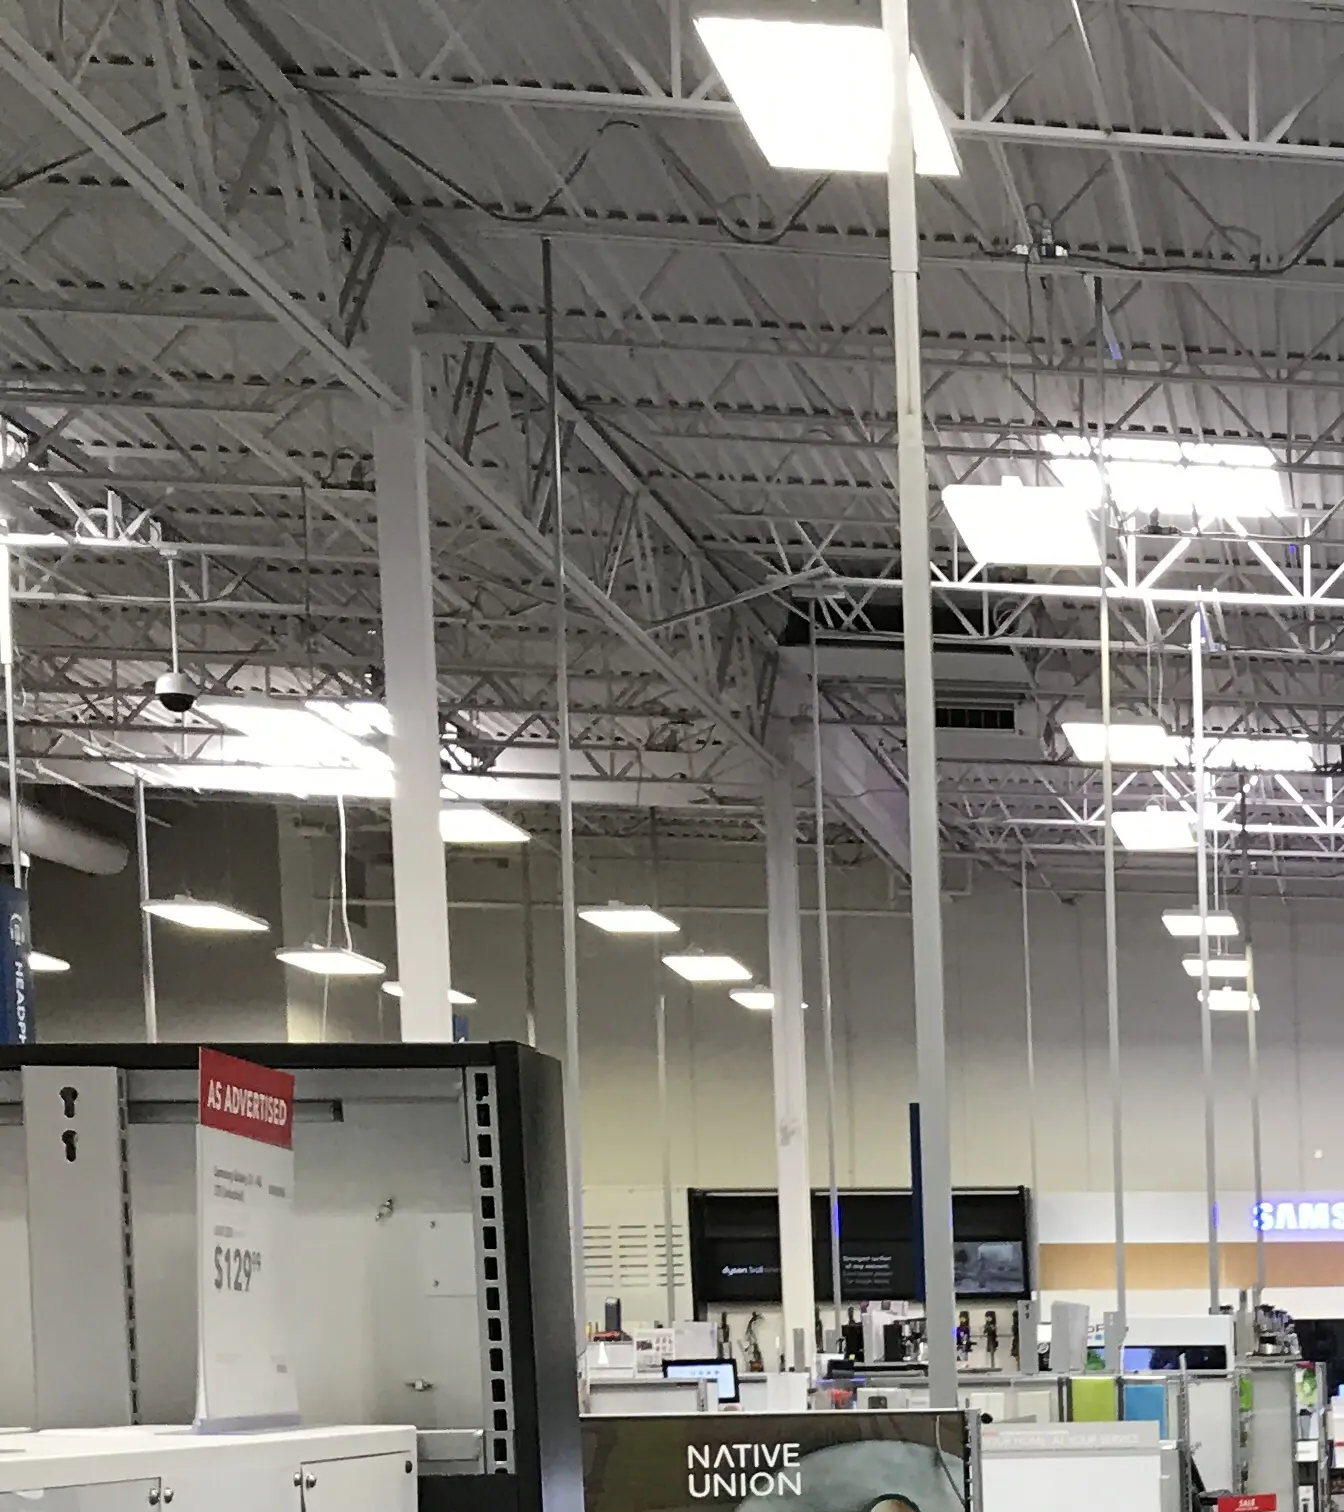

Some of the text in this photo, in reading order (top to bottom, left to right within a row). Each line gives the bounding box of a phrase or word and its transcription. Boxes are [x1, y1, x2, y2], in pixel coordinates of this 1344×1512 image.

[207, 1079, 288, 1126] AS ADVERTISED
[687, 1443, 800, 1469] NATIVE
[687, 1471, 801, 1498] UNION
